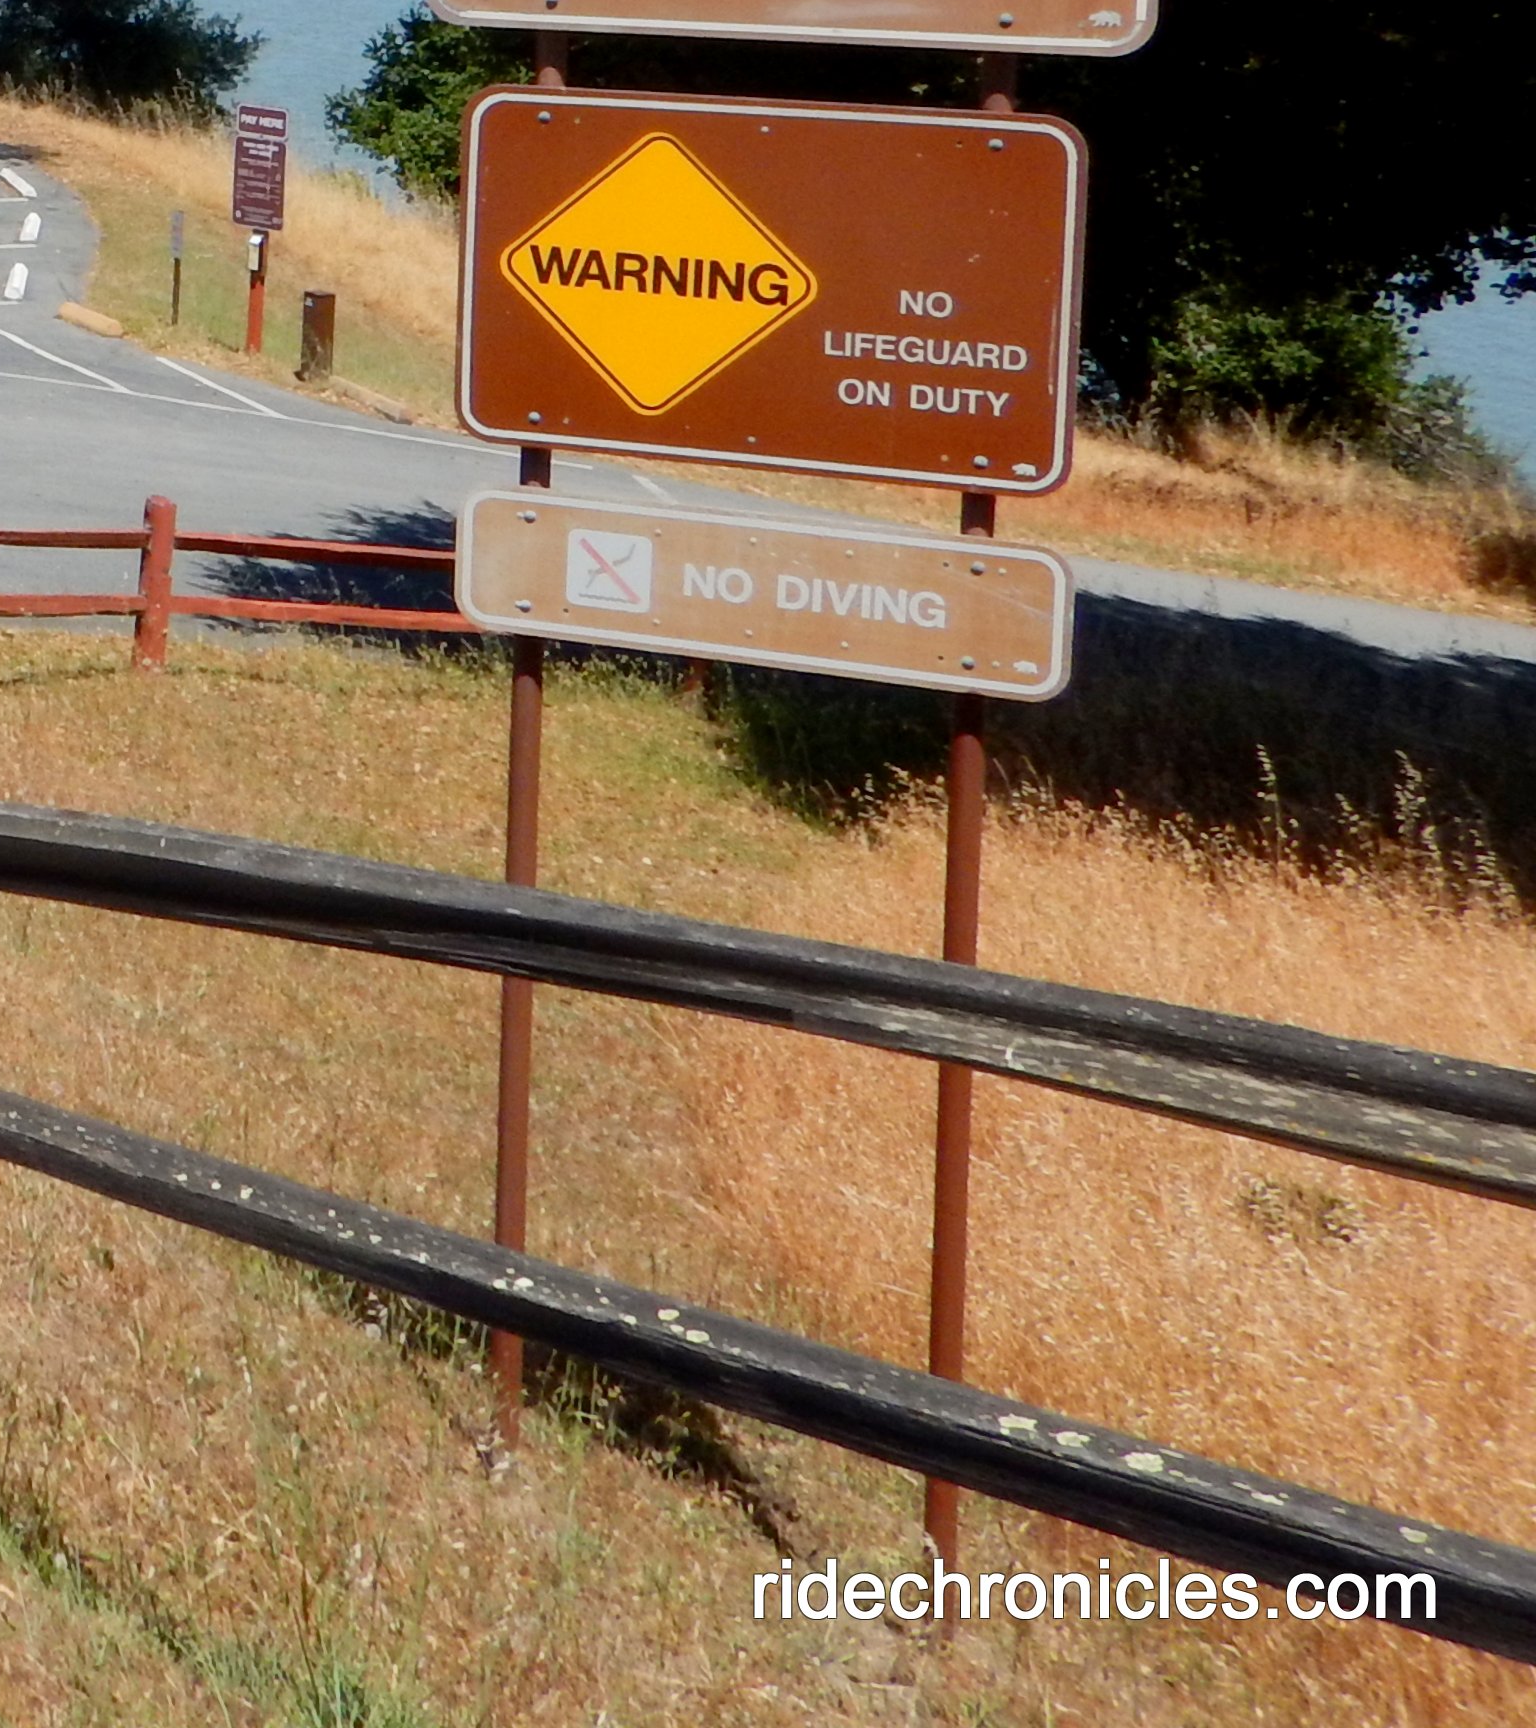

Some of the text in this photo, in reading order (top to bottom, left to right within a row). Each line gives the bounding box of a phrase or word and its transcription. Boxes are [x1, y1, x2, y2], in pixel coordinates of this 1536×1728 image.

[529, 244, 790, 308] WARNING
[899, 290, 954, 319] NO
[824, 330, 1028, 372] LIFEGUARD
[837, 377, 1011, 418] ON DUTY
[682, 562, 947, 629] NO DIVING
